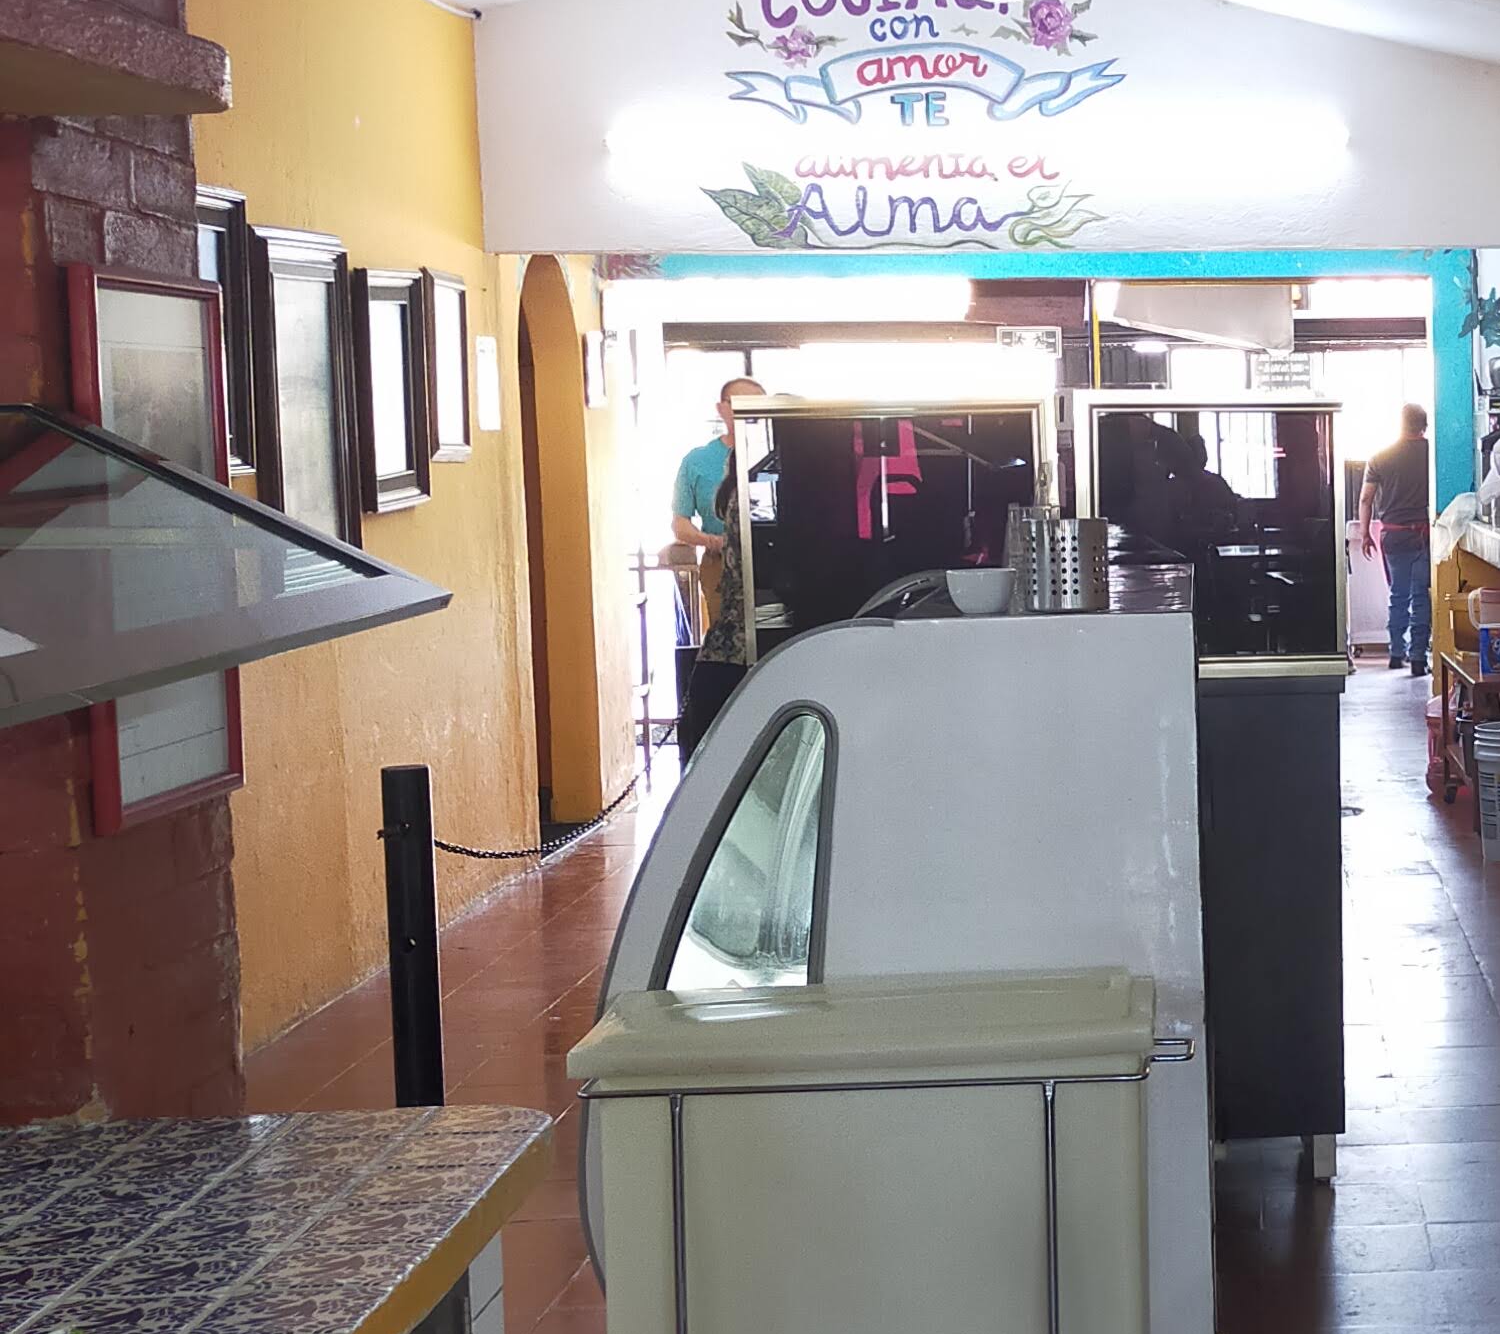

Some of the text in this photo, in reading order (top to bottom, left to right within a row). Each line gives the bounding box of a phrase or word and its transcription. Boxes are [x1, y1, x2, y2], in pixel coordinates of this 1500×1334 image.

[868, 12, 940, 42] con
[855, 52, 989, 87] amor
[890, 90, 950, 127] TE
[772, 182, 1032, 239] Alma
